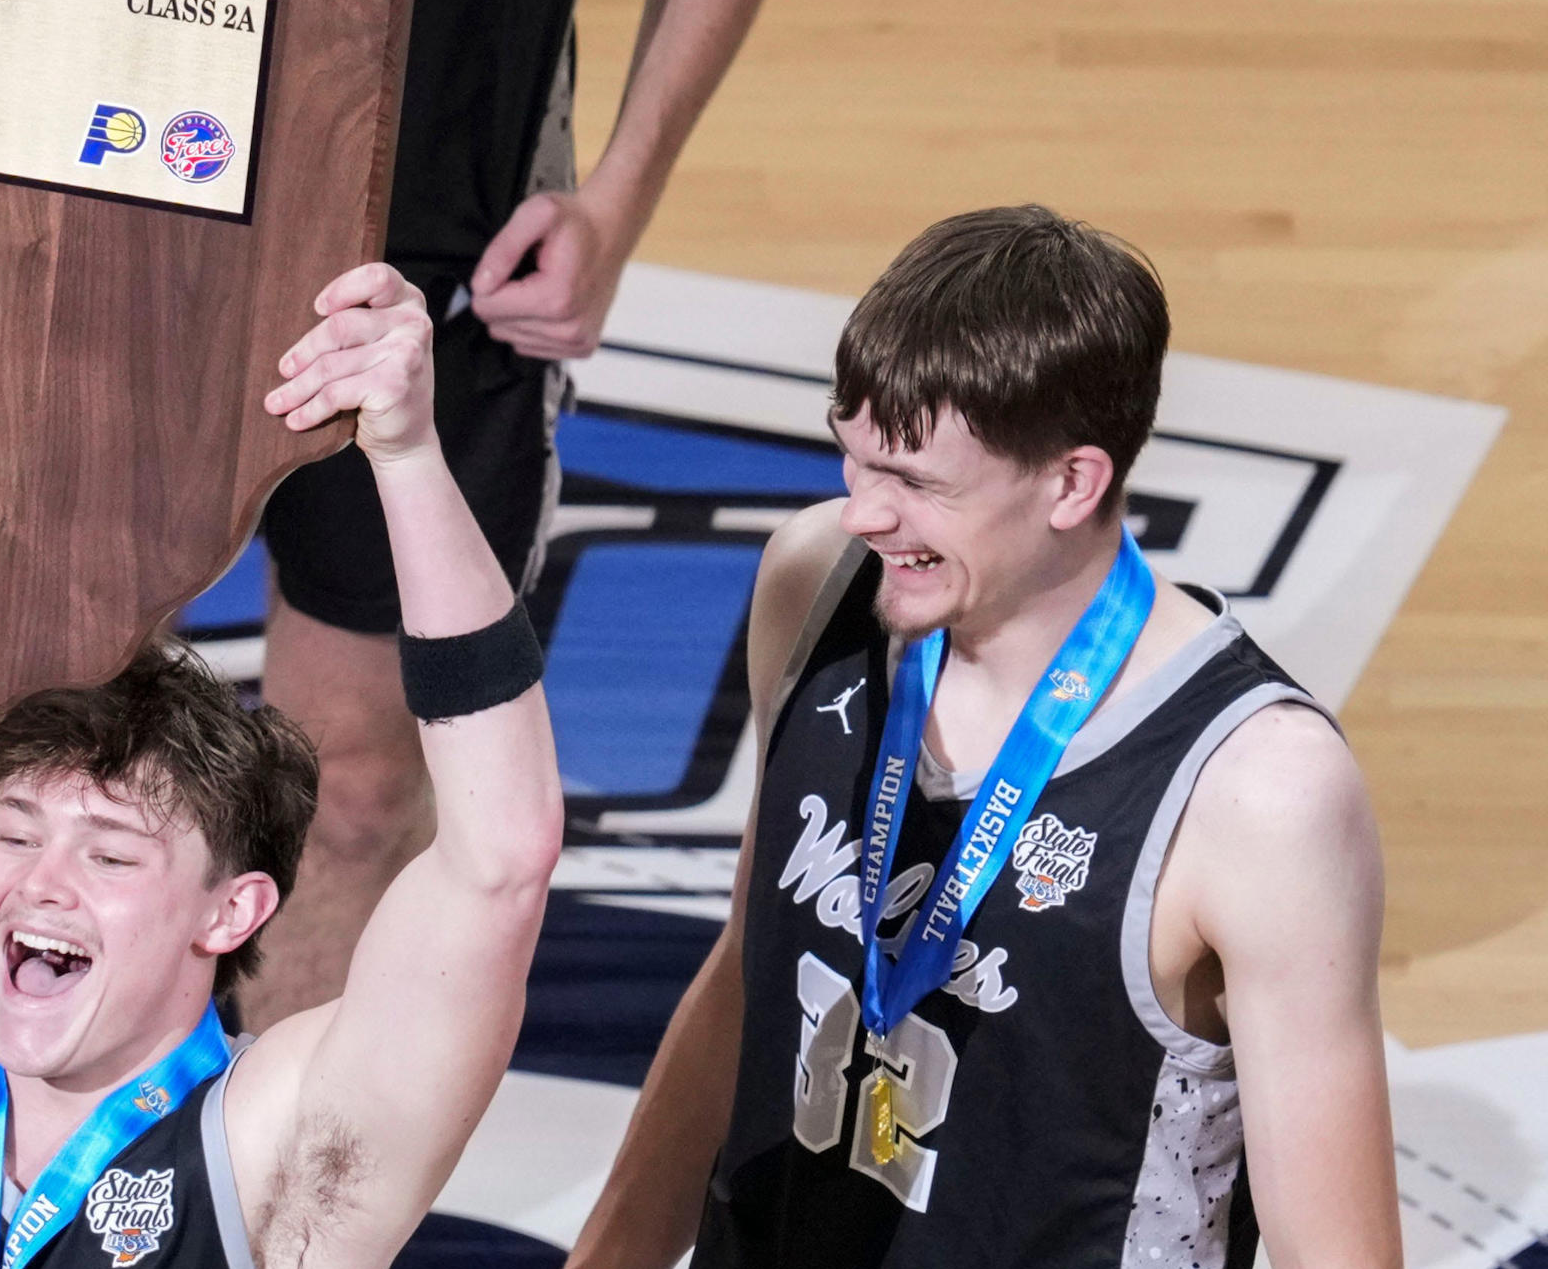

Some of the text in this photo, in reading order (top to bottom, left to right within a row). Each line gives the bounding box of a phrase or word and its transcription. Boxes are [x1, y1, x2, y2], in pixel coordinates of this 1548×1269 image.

[222, 4, 255, 33] 2A
[163, 129, 233, 163] Fever
[173, 117, 221, 137] INDIANA
[864, 755, 906, 904] CHAMPION
[1022, 816, 1094, 857] State
[922, 778, 1022, 942] BASKETBALL
[1015, 840, 1086, 890] Finals
[778, 794, 1018, 1013] Woles
[93, 1171, 171, 1201] State
[90, 1199, 169, 1234] Finals
